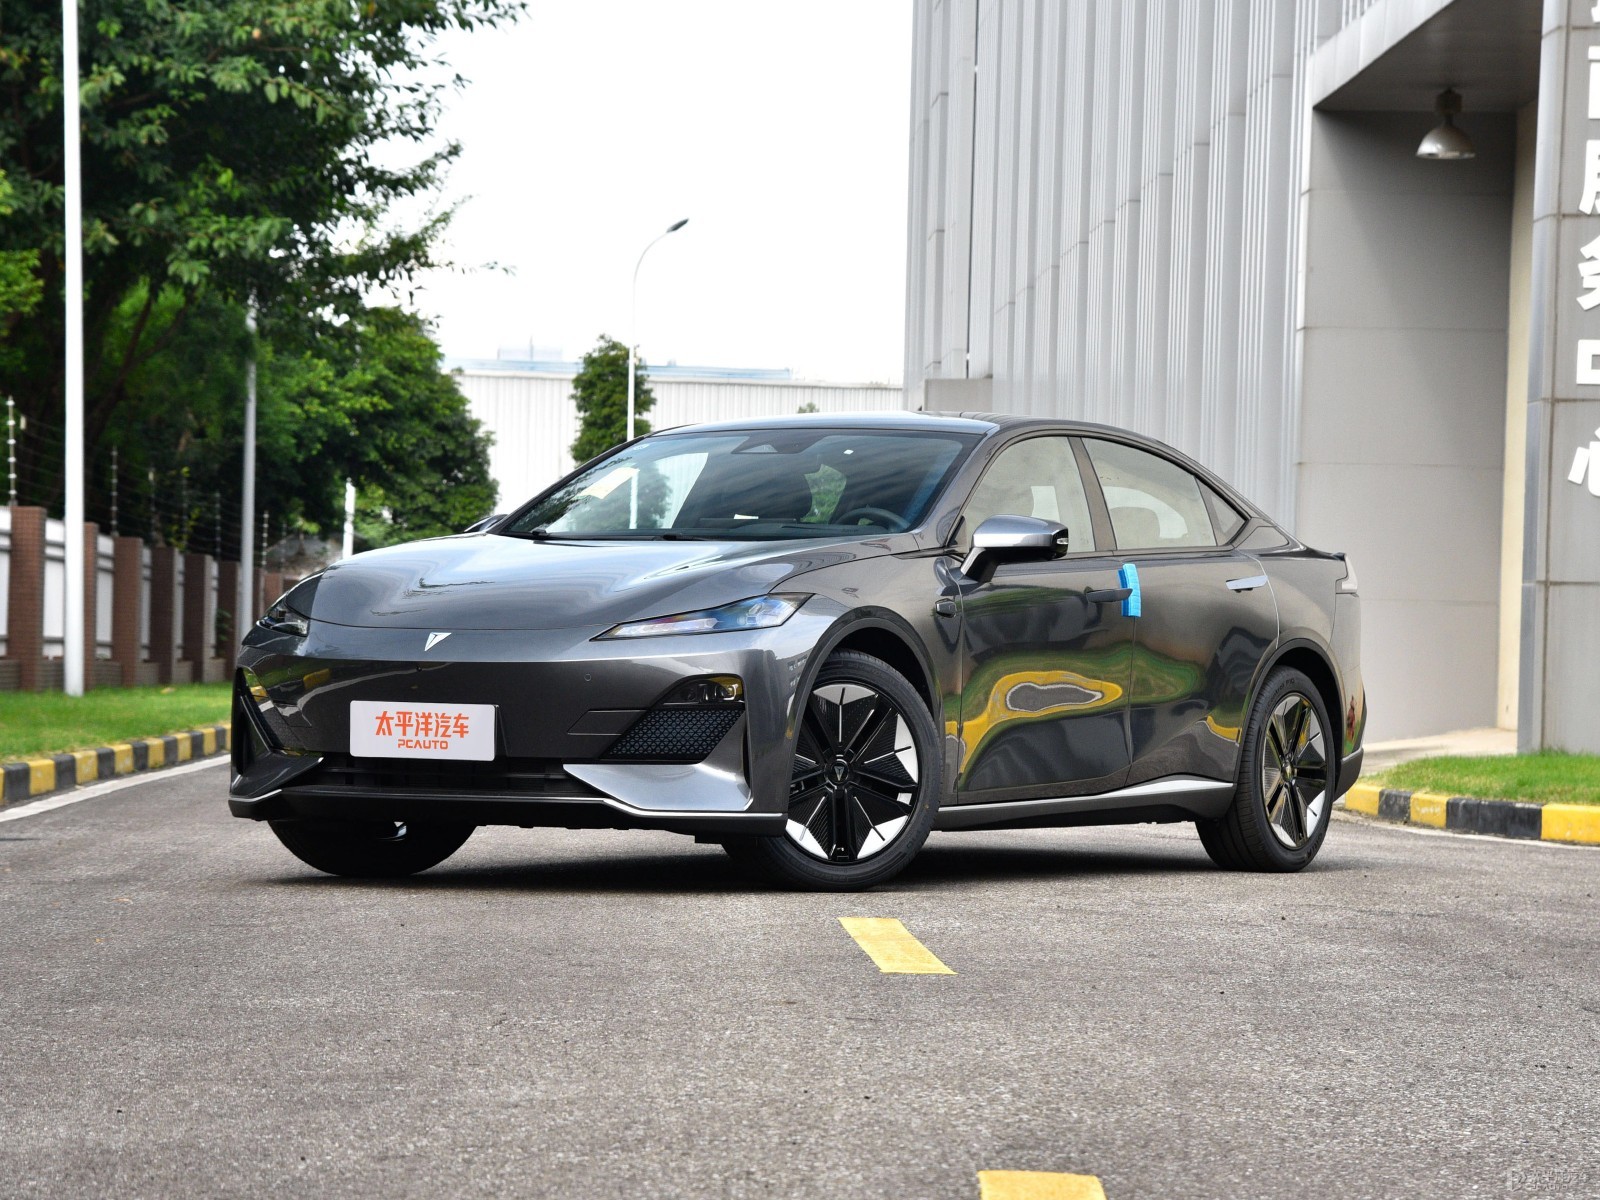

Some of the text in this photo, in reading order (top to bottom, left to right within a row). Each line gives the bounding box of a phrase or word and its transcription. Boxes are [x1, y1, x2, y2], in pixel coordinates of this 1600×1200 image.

[375, 711, 469, 738] 太平洋汽车
[398, 739, 449, 750] PCAUTO
